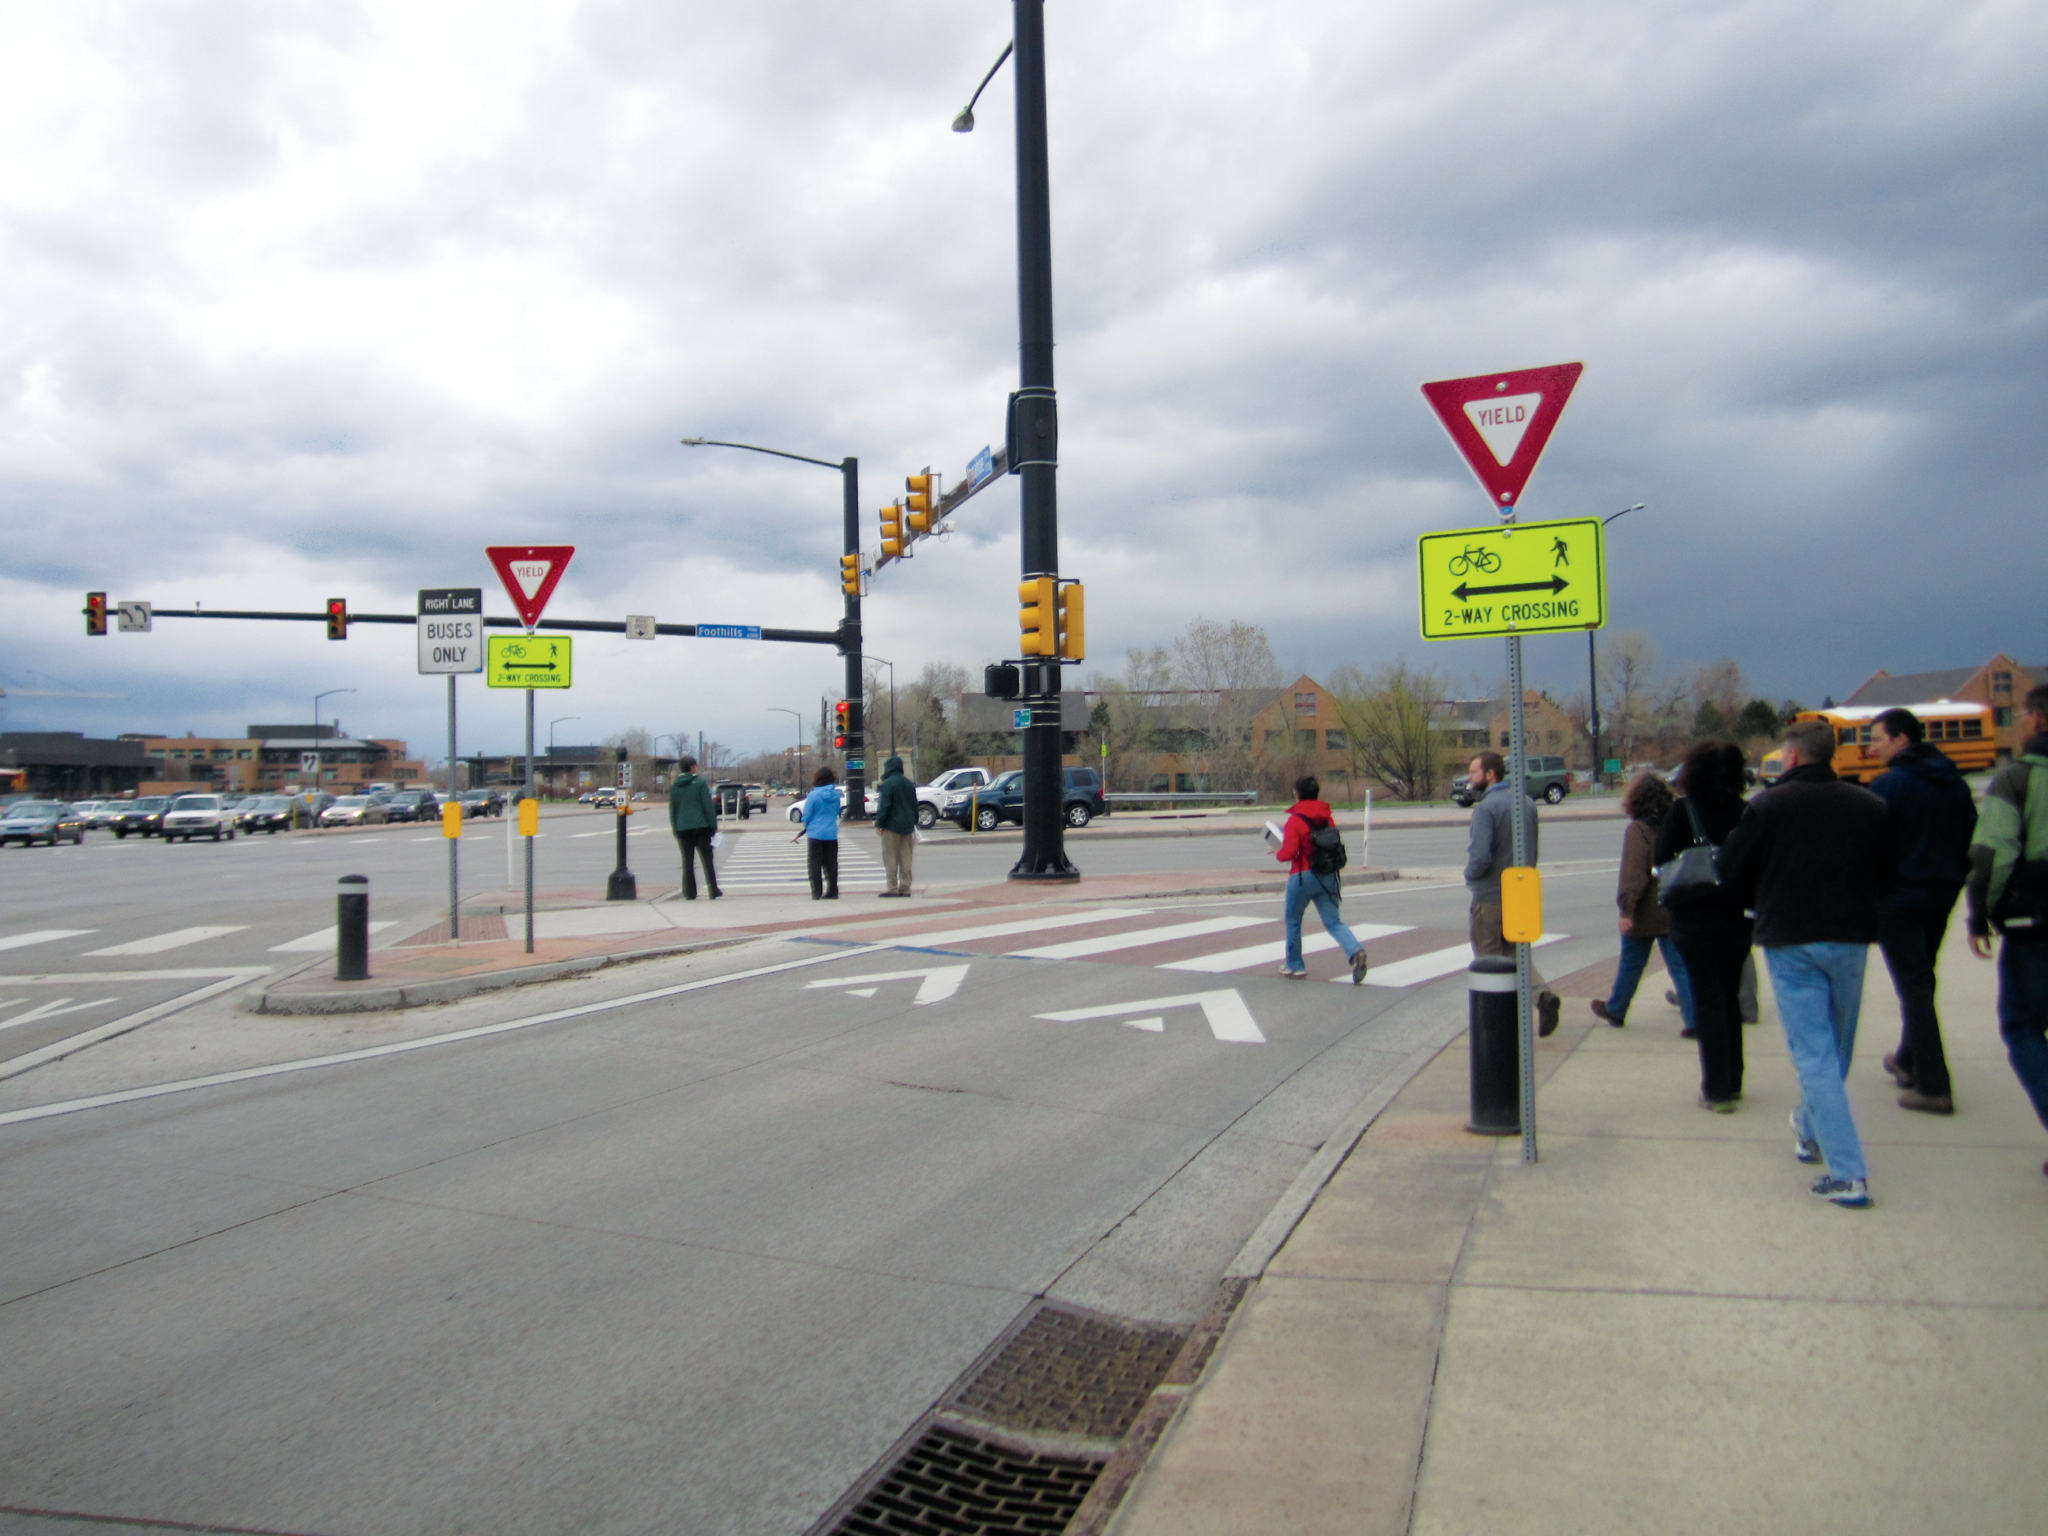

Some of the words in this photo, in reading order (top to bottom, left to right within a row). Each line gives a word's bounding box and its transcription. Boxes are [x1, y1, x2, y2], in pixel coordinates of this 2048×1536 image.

[1478, 405, 1525, 426] YIELD
[517, 567, 544, 577] YIELD
[425, 599, 449, 610] RIGHT
[452, 598, 475, 609] LANE
[1444, 606, 1492, 626] 2-WAY
[1501, 599, 1579, 622] CROSSING
[427, 623, 473, 639] BUSES
[698, 626, 743, 638] Foothills
[433, 647, 467, 663] ONLY
[497, 674, 521, 683] 2-WAY
[525, 674, 561, 683] CROSSING
